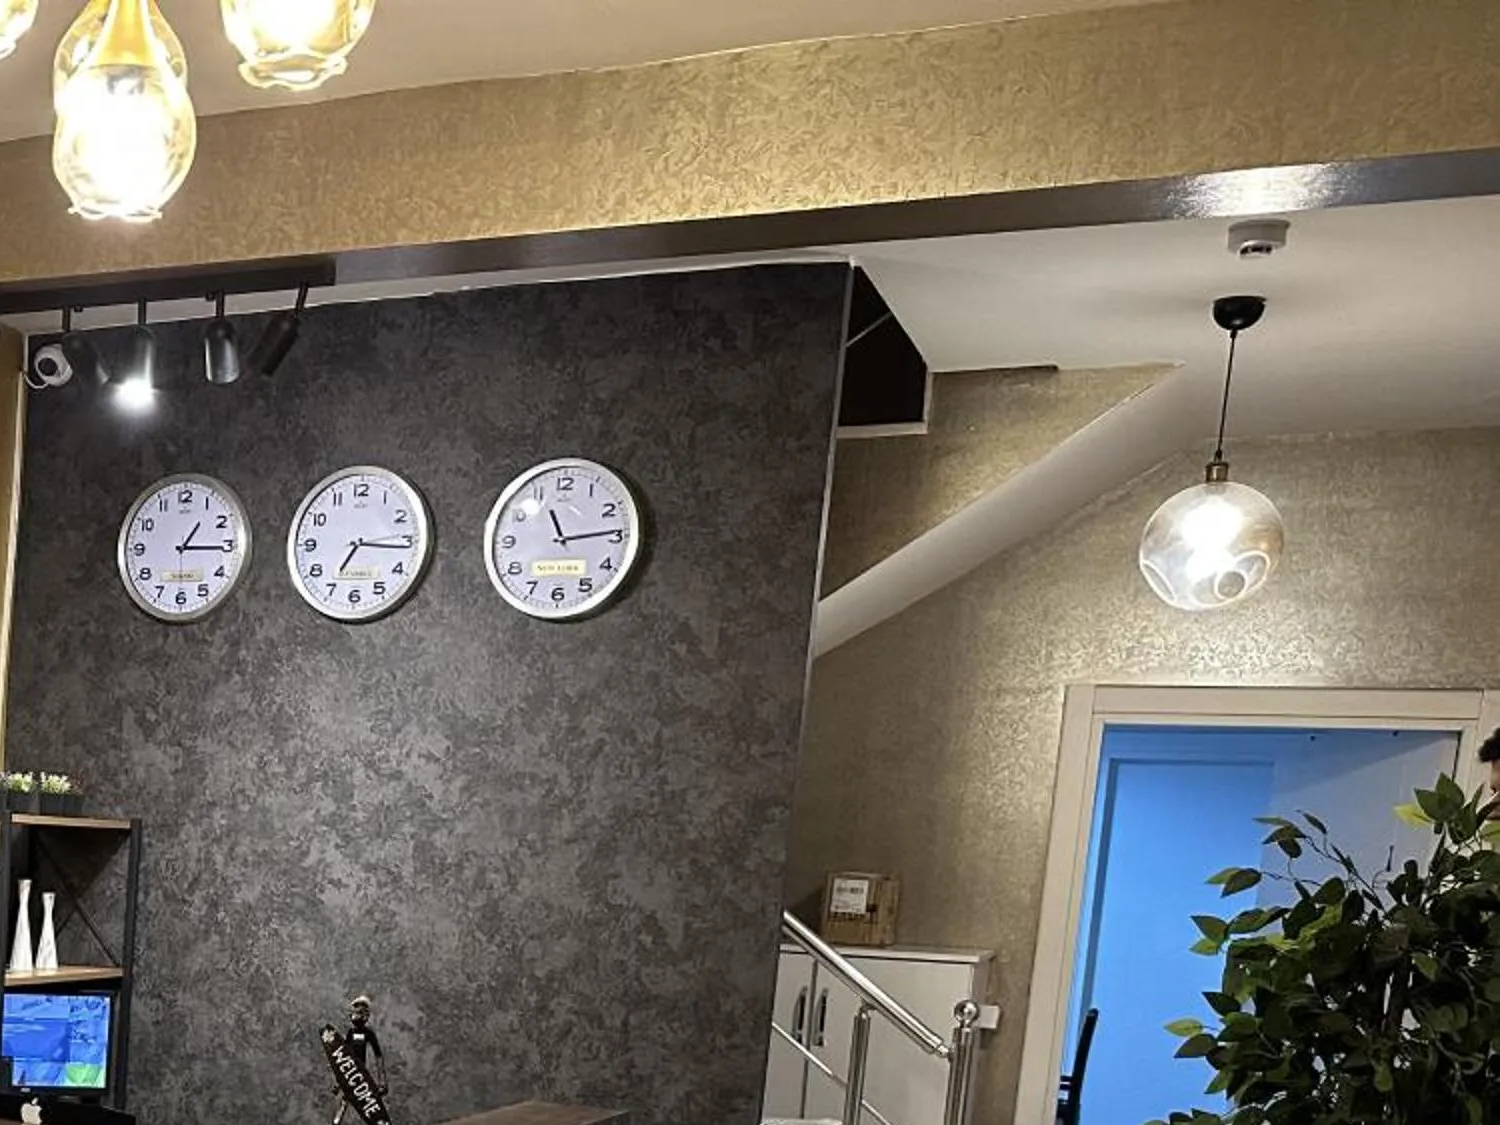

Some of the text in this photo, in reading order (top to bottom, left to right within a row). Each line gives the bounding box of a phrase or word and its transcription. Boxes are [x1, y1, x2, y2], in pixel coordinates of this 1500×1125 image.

[353, 483, 369, 497] 12
[556, 477, 574, 491] 12
[178, 490, 193, 503] 12
[333, 492, 342, 506] 11
[534, 486, 543, 500] 11
[159, 500, 168, 512] 11
[601, 503, 616, 518] 2
[216, 515, 227, 529] 2
[313, 513, 326, 527] 10
[394, 509, 407, 523] 2
[141, 518, 154, 531] 10
[402, 535, 413, 548] 3
[502, 535, 516, 548] 9
[608, 530, 623, 544] 3
[134, 543, 145, 556] 9
[222, 539, 233, 552] 3
[304, 538, 317, 552] 9
[309, 564, 322, 577] 8
[392, 562, 404, 574] 4
[507, 562, 522, 575] 8
[600, 557, 613, 571] 4
[139, 567, 151, 581] 8
[214, 565, 224, 578] 4
[155, 585, 165, 598] 7
[197, 583, 209, 597] 5
[326, 583, 337, 597] 7
[373, 581, 385, 595] 5
[526, 581, 538, 595] 7
[578, 577, 593, 592] 5
[175, 591, 186, 604] 6
[348, 589, 361, 603] 6
[551, 587, 565, 601] 6
[332, 1045, 381, 1118] WELCOME
